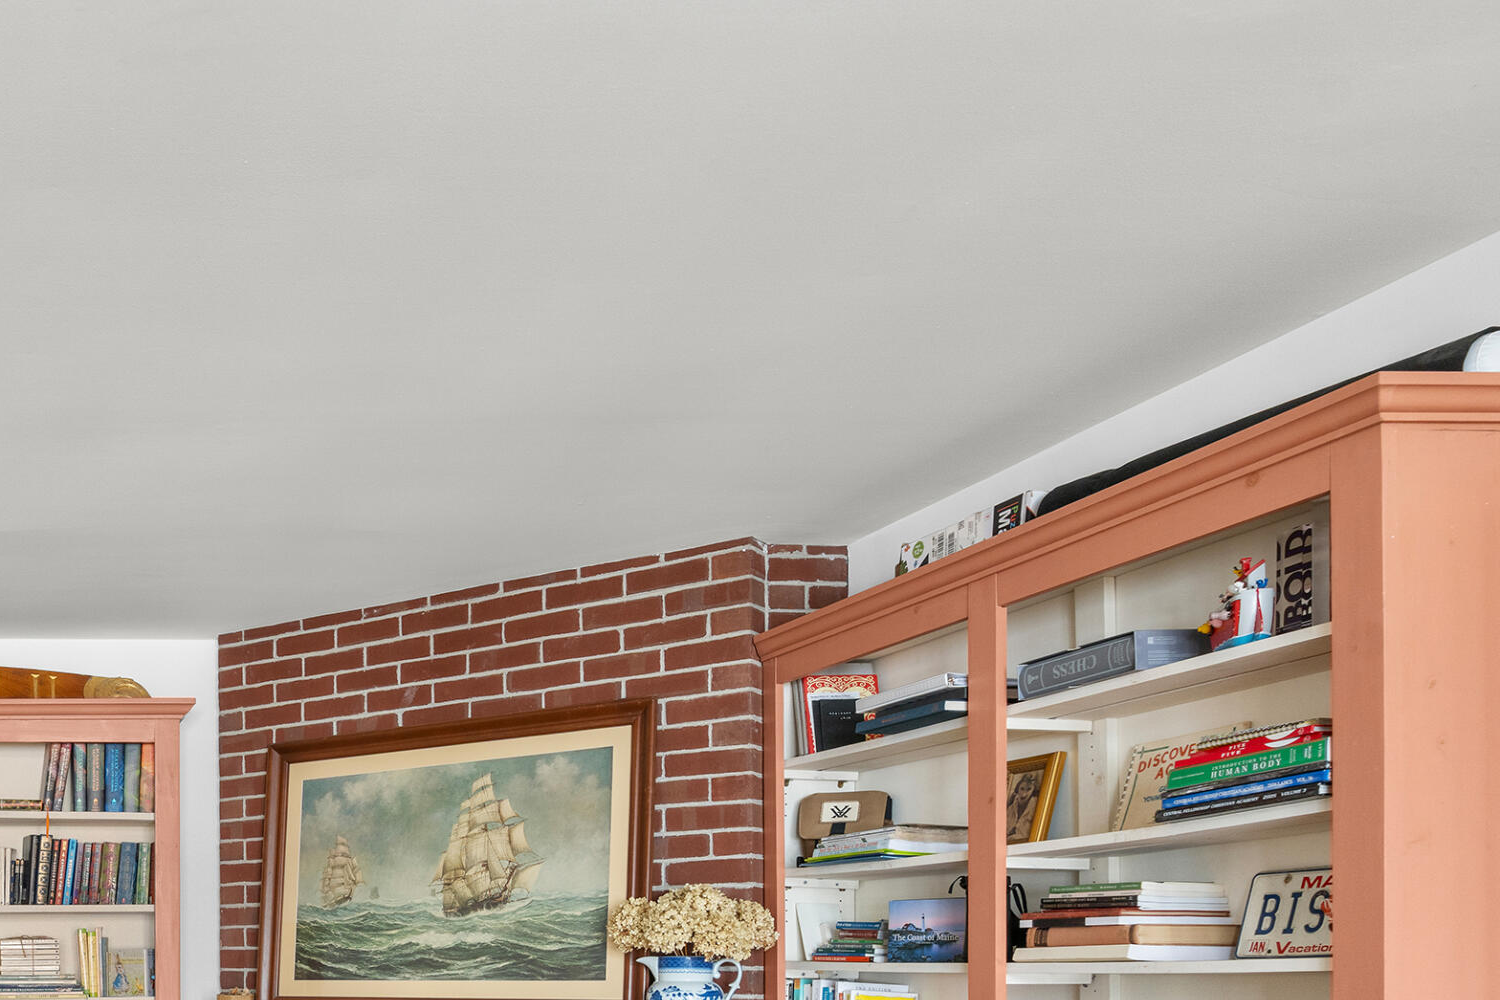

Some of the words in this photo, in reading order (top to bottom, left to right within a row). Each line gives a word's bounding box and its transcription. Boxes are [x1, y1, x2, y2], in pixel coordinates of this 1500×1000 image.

[1052, 654, 1097, 679] CHESS
[1138, 743, 1198, 774] DISCOVE
[1212, 758, 1257, 770] INTRODUCTION
[1211, 766, 1249, 779] HUMAN
[1252, 758, 1283, 771] BODY
[1301, 875, 1332, 889] MA
[927, 933, 934, 941] of
[936, 933, 959, 941] Maine
